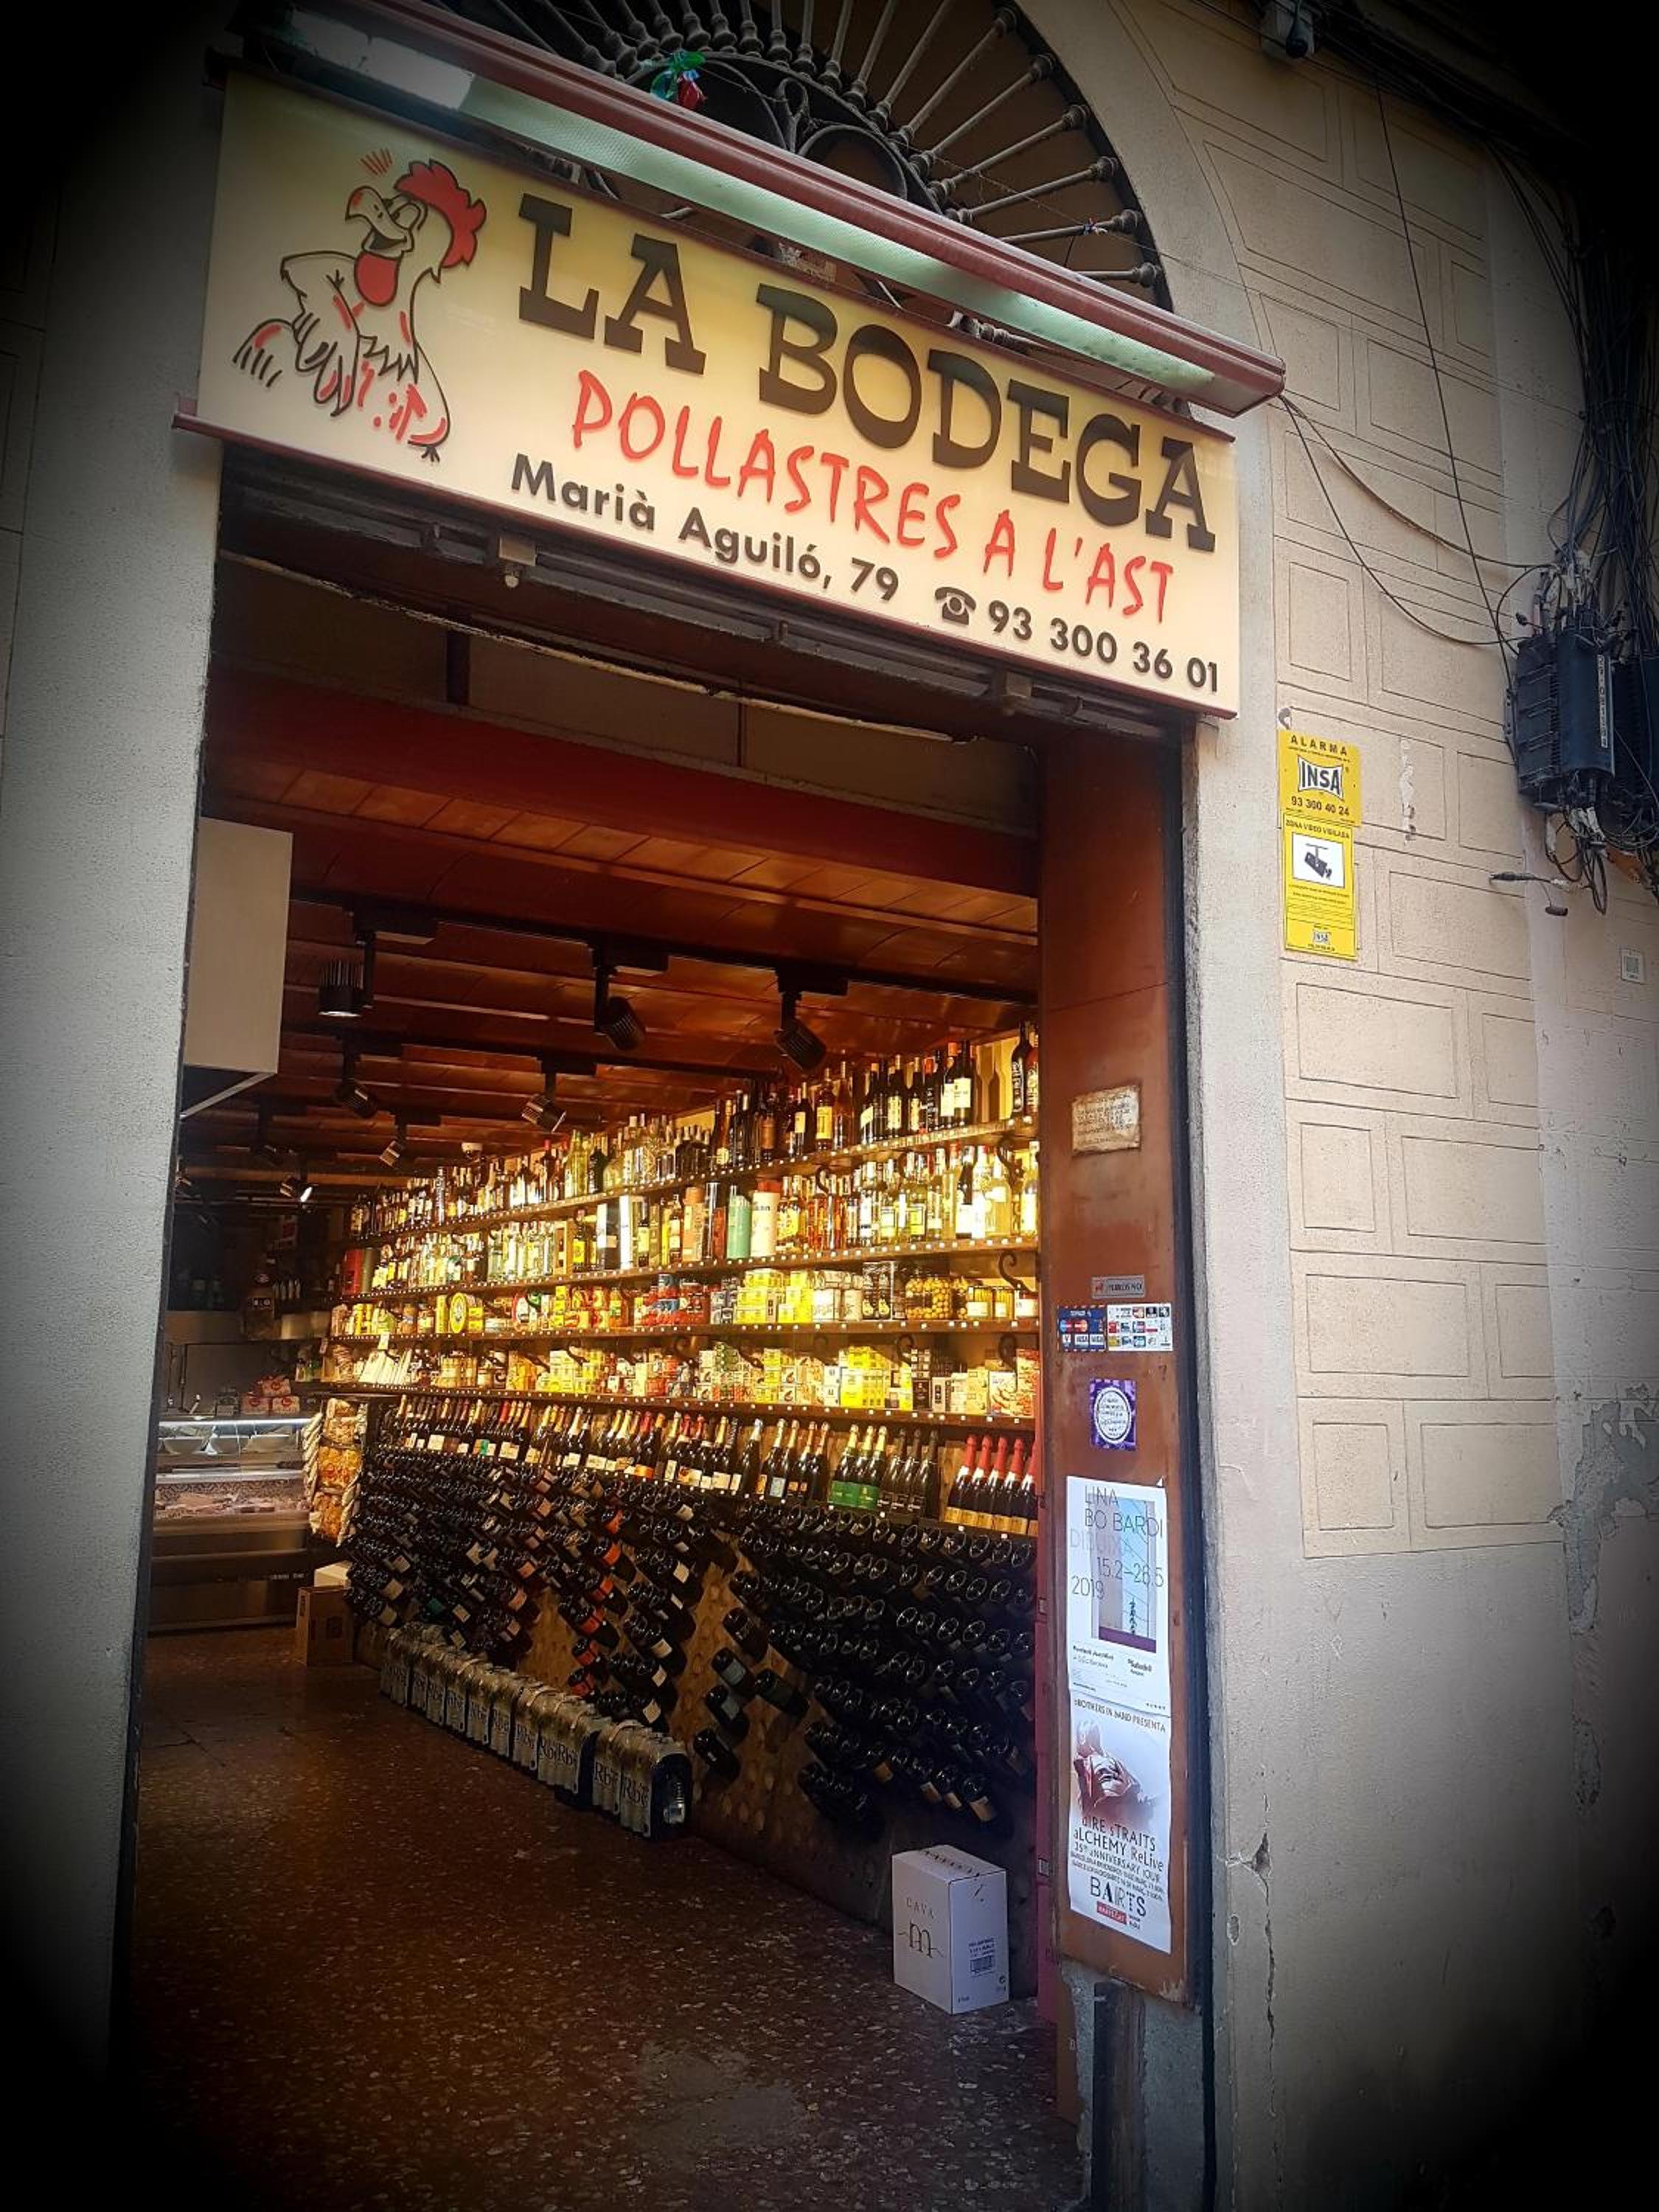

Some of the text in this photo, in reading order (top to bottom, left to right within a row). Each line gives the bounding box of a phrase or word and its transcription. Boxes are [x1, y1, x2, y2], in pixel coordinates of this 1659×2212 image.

[519, 192, 1216, 553] LA BODEGA
[571, 369, 1175, 624] POLLASTRES A L'AST
[511, 452, 1218, 693] Marià Aguiló, 79 93 300 36 01
[1291, 734, 1347, 756] ALARMA
[1301, 760, 1340, 796] INSA
[1291, 796, 1302, 807] 93
[1338, 806, 1349, 815] 24
[1286, 819, 1302, 829] ZONA
[1085, 1485, 1119, 1508] LINA
[1085, 1508, 1163, 1538] BO BARDI
[1071, 1576, 1105, 1601] 2019
[1091, 1876, 1146, 1917] BARTS
